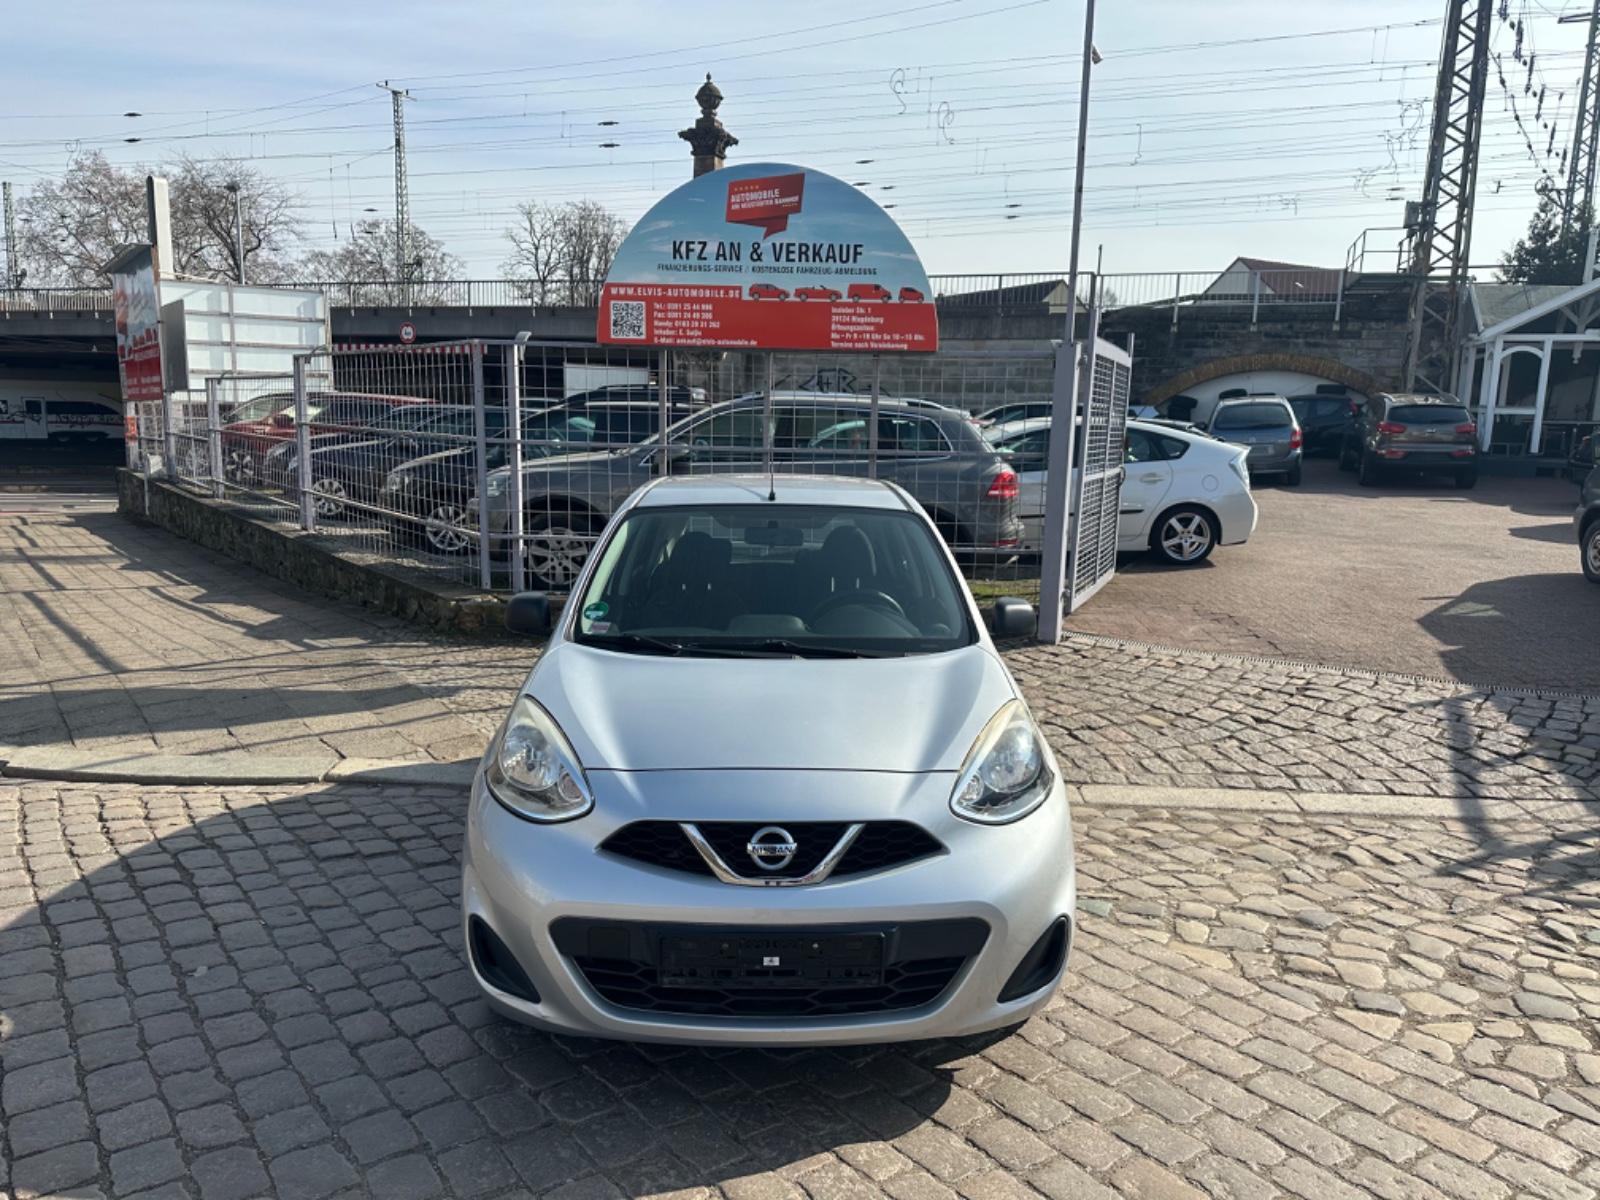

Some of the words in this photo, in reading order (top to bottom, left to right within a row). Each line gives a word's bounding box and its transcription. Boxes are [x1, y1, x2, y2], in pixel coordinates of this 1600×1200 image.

[731, 188, 780, 202] AUTOMOBILE
[672, 240, 707, 261] KFZ
[715, 241, 741, 261] AN
[750, 242, 763, 263] &
[771, 242, 864, 264] VERKAUF
[656, 264, 743, 273] FINANZIERUNGS-SERVICE
[751, 265, 794, 274] KOSTENLOSE
[796, 266, 877, 275] FAHRZEUG-ABMELDUNG
[610, 286, 740, 298] WWW.ELVIS-AUTOMOBILE.DE
[851, 315, 884, 324] Magdeburg
[751, 845, 793, 856] NISSAN
